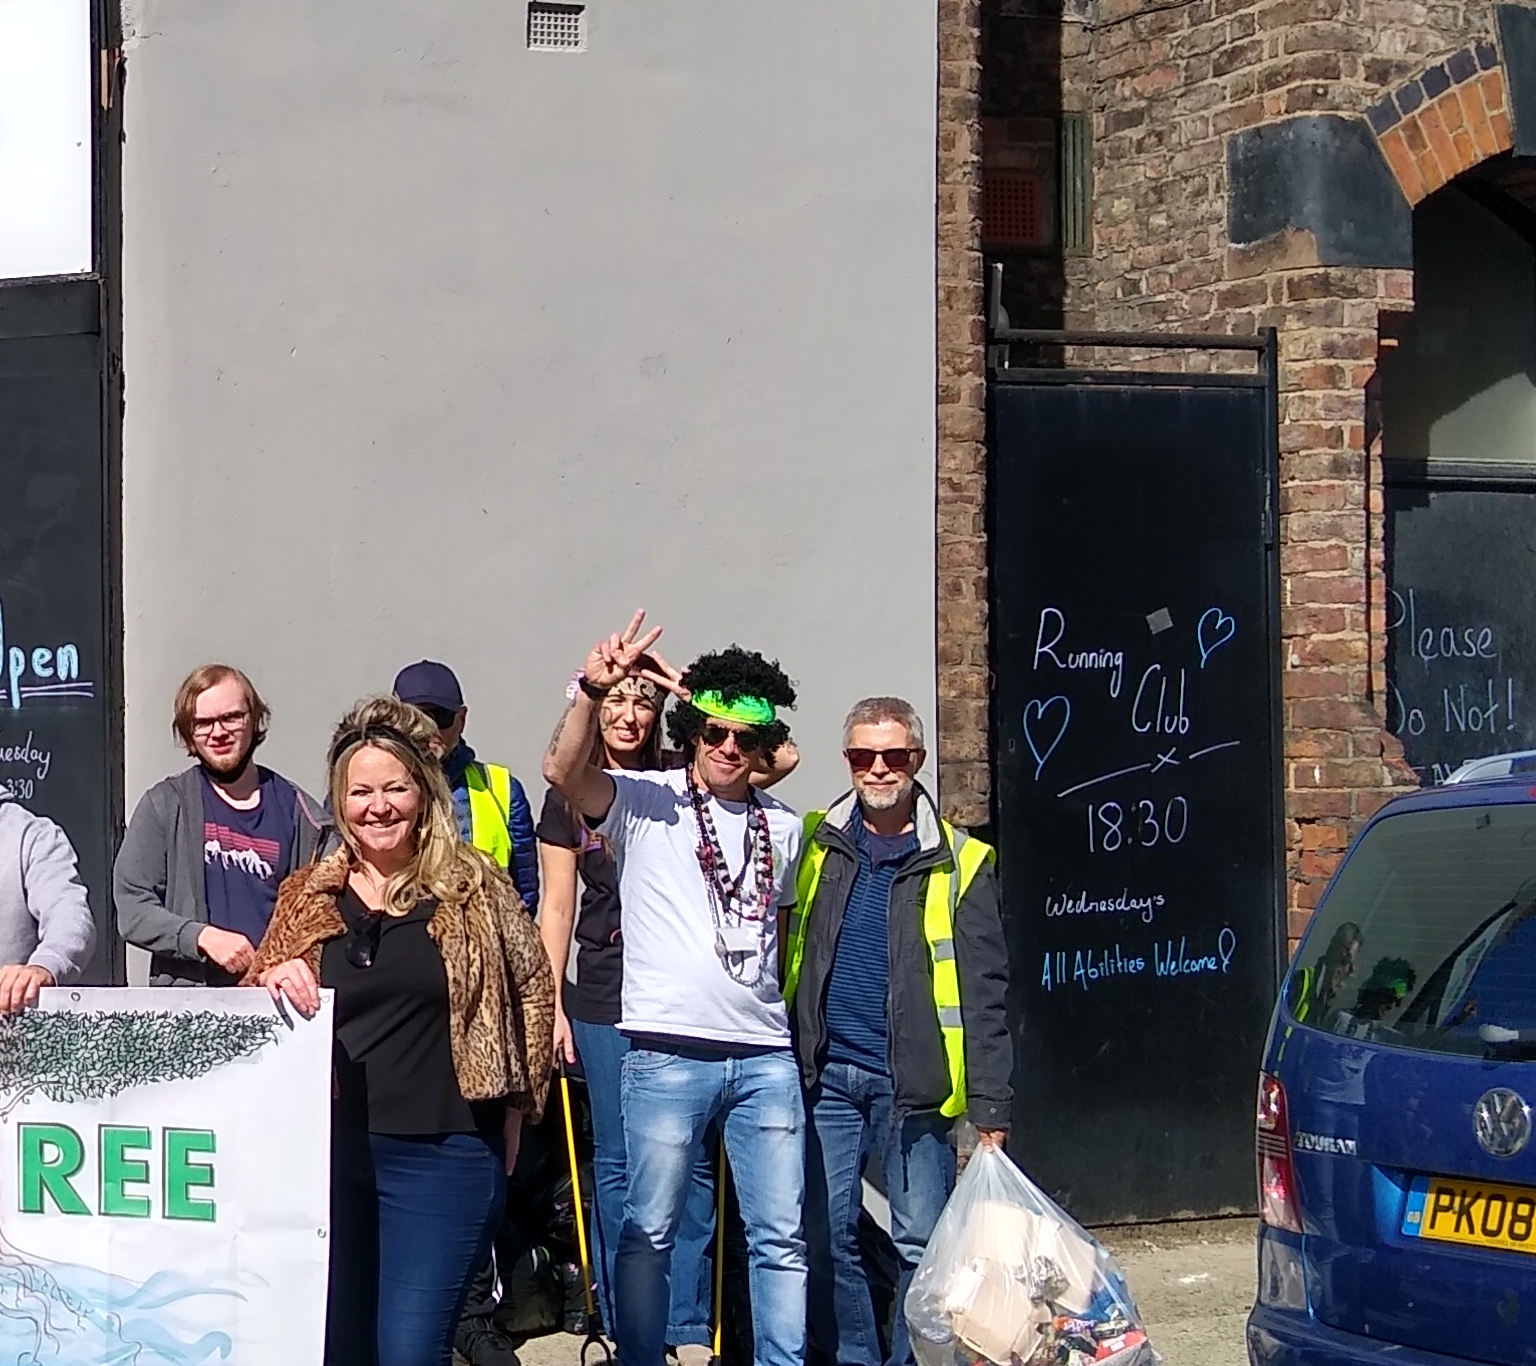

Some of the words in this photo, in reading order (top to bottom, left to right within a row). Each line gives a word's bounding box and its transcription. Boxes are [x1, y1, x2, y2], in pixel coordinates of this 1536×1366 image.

[1033, 608, 1124, 698] Running
[1132, 663, 1190, 734] Club
[1042, 952, 1066, 991] All
[1074, 944, 1145, 990] Abilities
[1429, 1186, 1536, 1242] PK08
